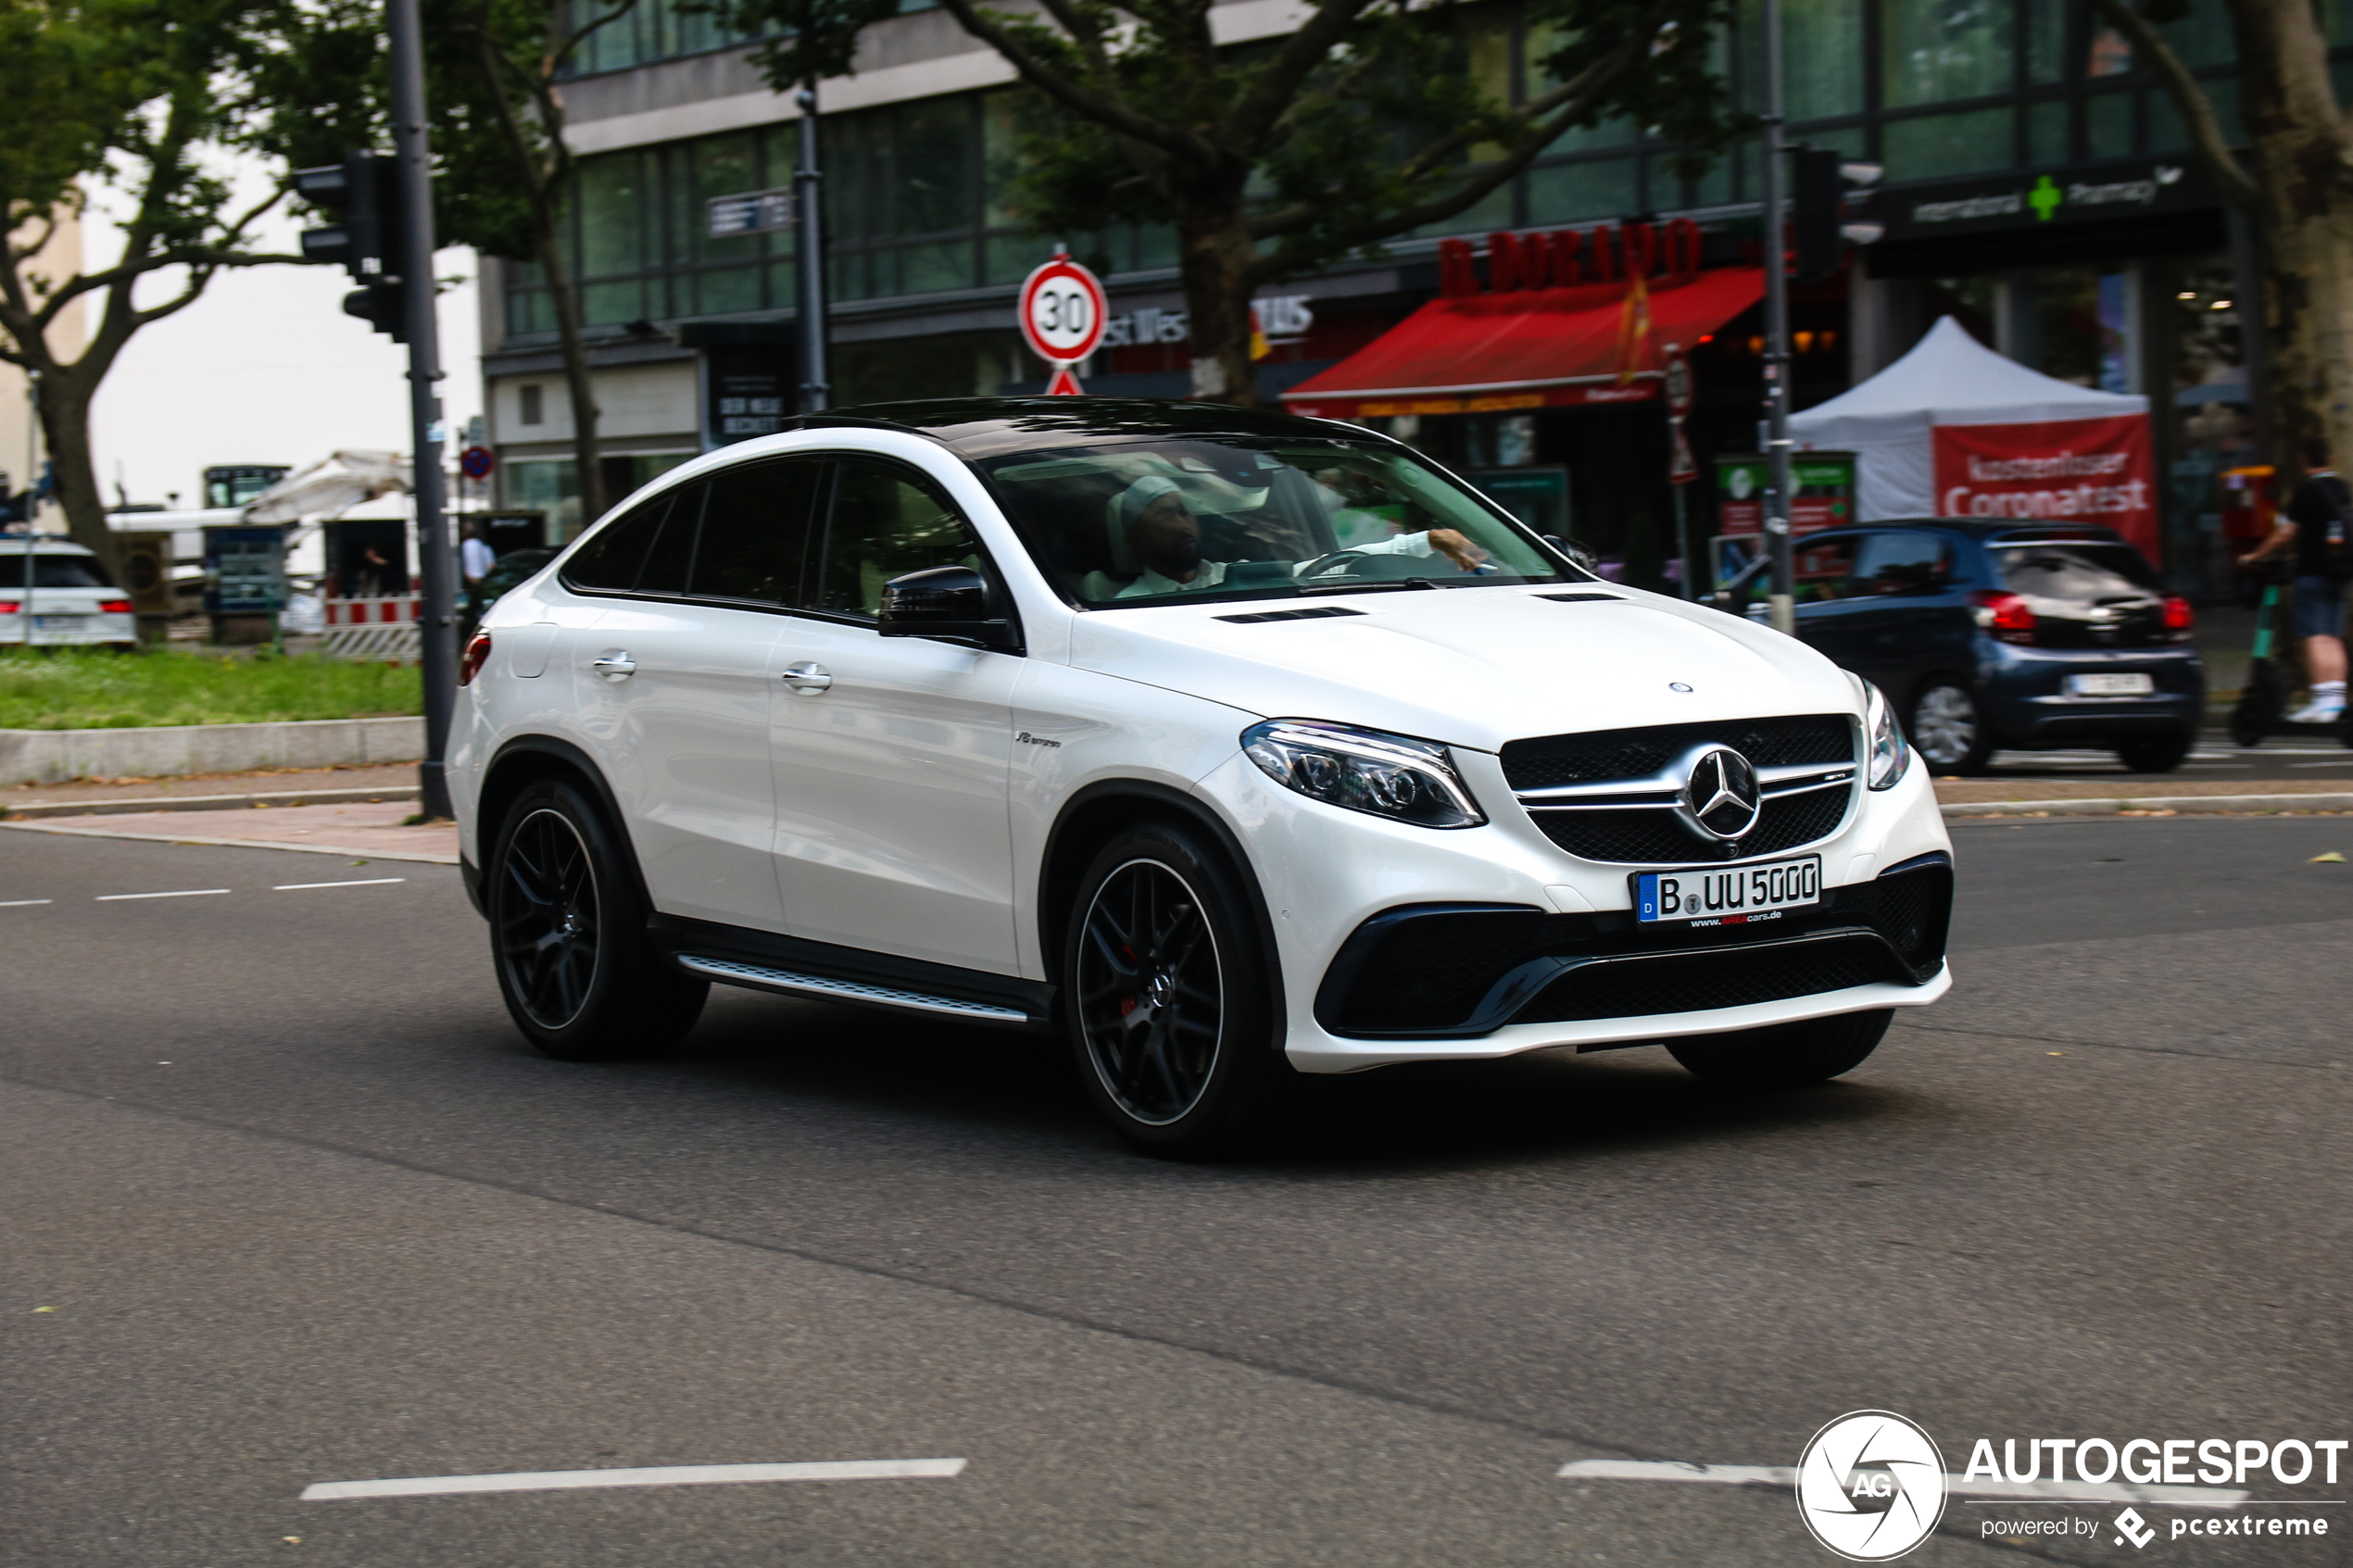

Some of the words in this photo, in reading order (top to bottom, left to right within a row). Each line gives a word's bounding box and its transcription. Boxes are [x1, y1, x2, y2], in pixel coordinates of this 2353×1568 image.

[2068, 181, 2156, 205] Pharmacy
[1039, 291, 1088, 333] 30
[1944, 480, 2149, 518] Coronatest
[1660, 878, 1680, 915] B
[1705, 872, 1744, 911] UU
[1753, 863, 1816, 906] 5000
[1644, 903, 1653, 913] D
[1691, 910, 1782, 928] www.AREAcars.de
